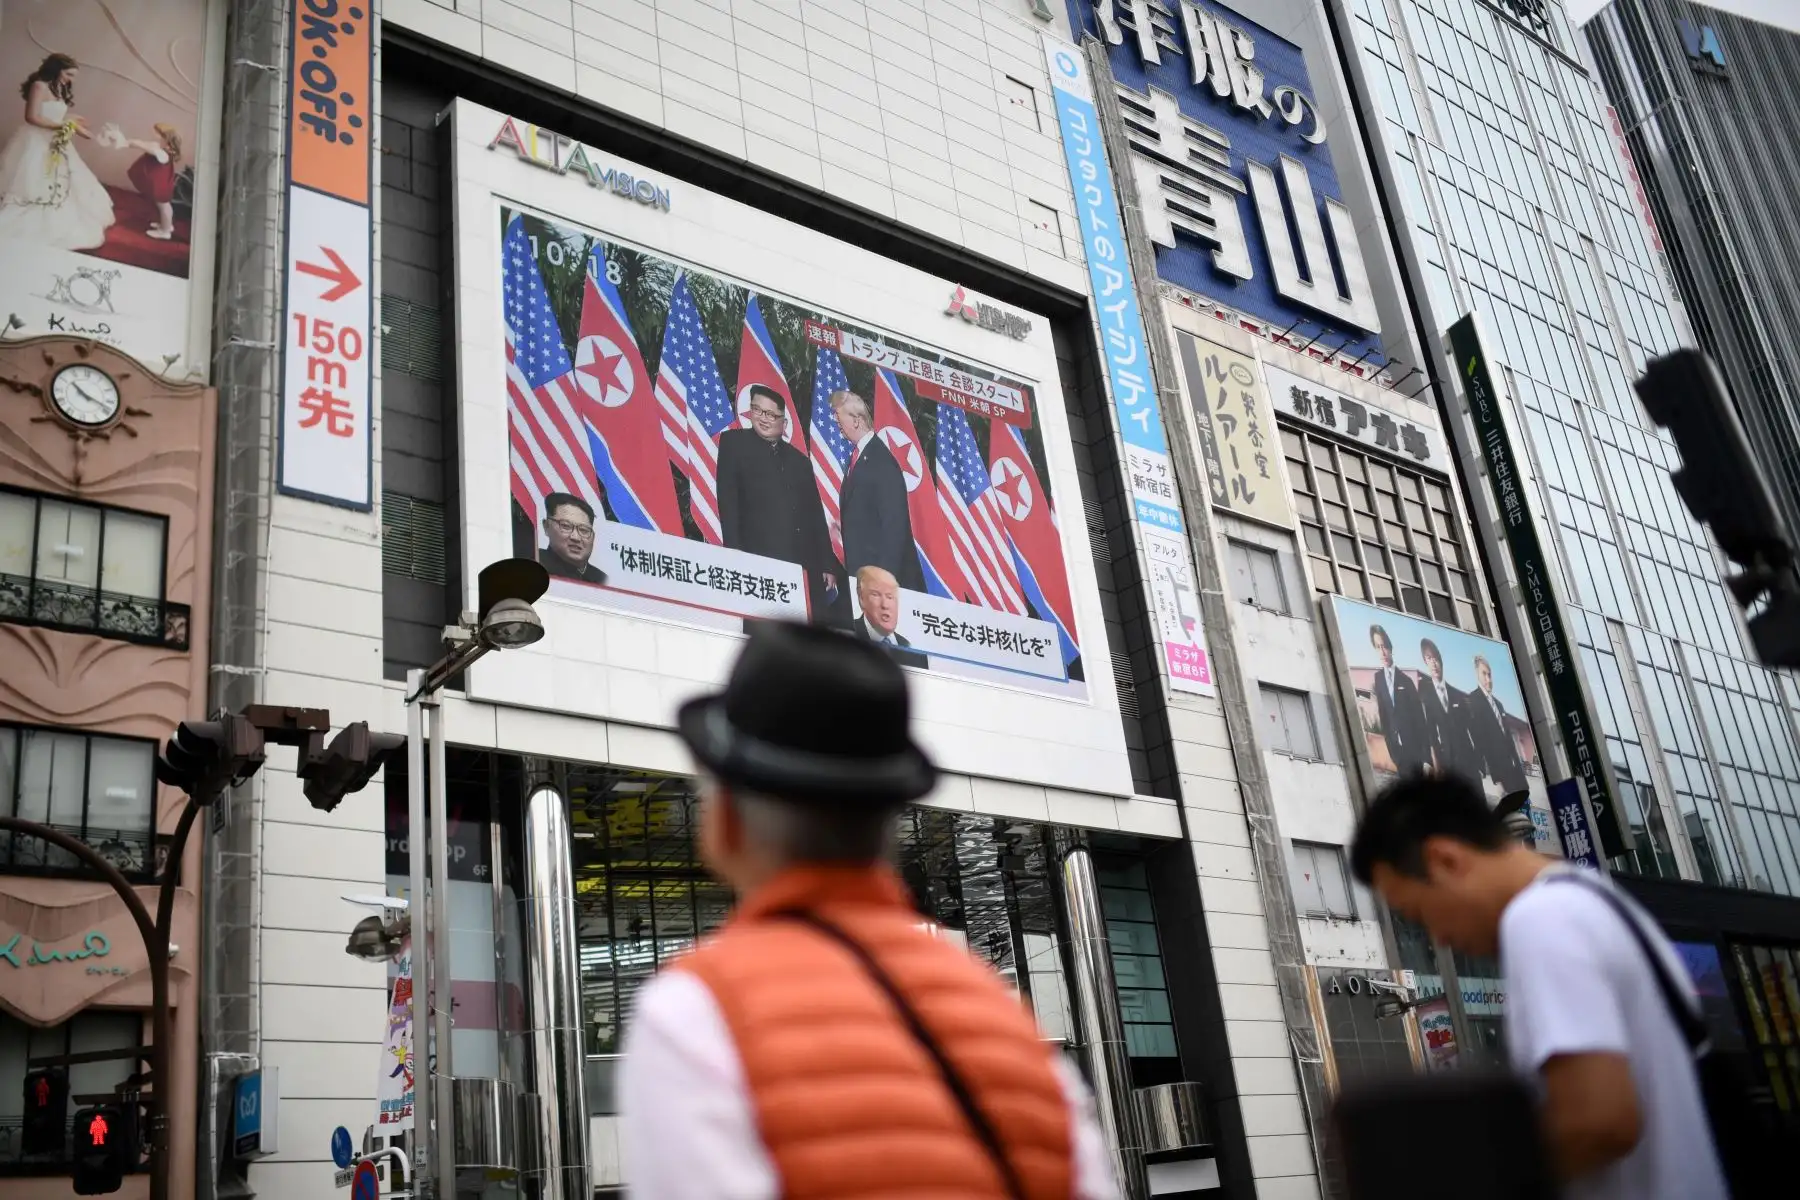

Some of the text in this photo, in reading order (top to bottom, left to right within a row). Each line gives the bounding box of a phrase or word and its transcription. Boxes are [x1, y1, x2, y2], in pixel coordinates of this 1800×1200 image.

[1113, 82, 1382, 335] 青山
[807, 325, 837, 347] 速報
[941, 388, 1006, 418] FNN 米朝 SP
[949, 371, 1021, 408] 会談スタート
[1205, 353, 1256, 505] ルノアール
[1240, 389, 1270, 480] 喫茶室
[1472, 376, 1523, 527] SMBC 三井住友銀行
[1133, 473, 1172, 498] 新宿店
[1152, 542, 1177, 558] アルタ
[1172, 660, 1206, 678] 新宿8F
[472, 864, 488, 877] 6F
